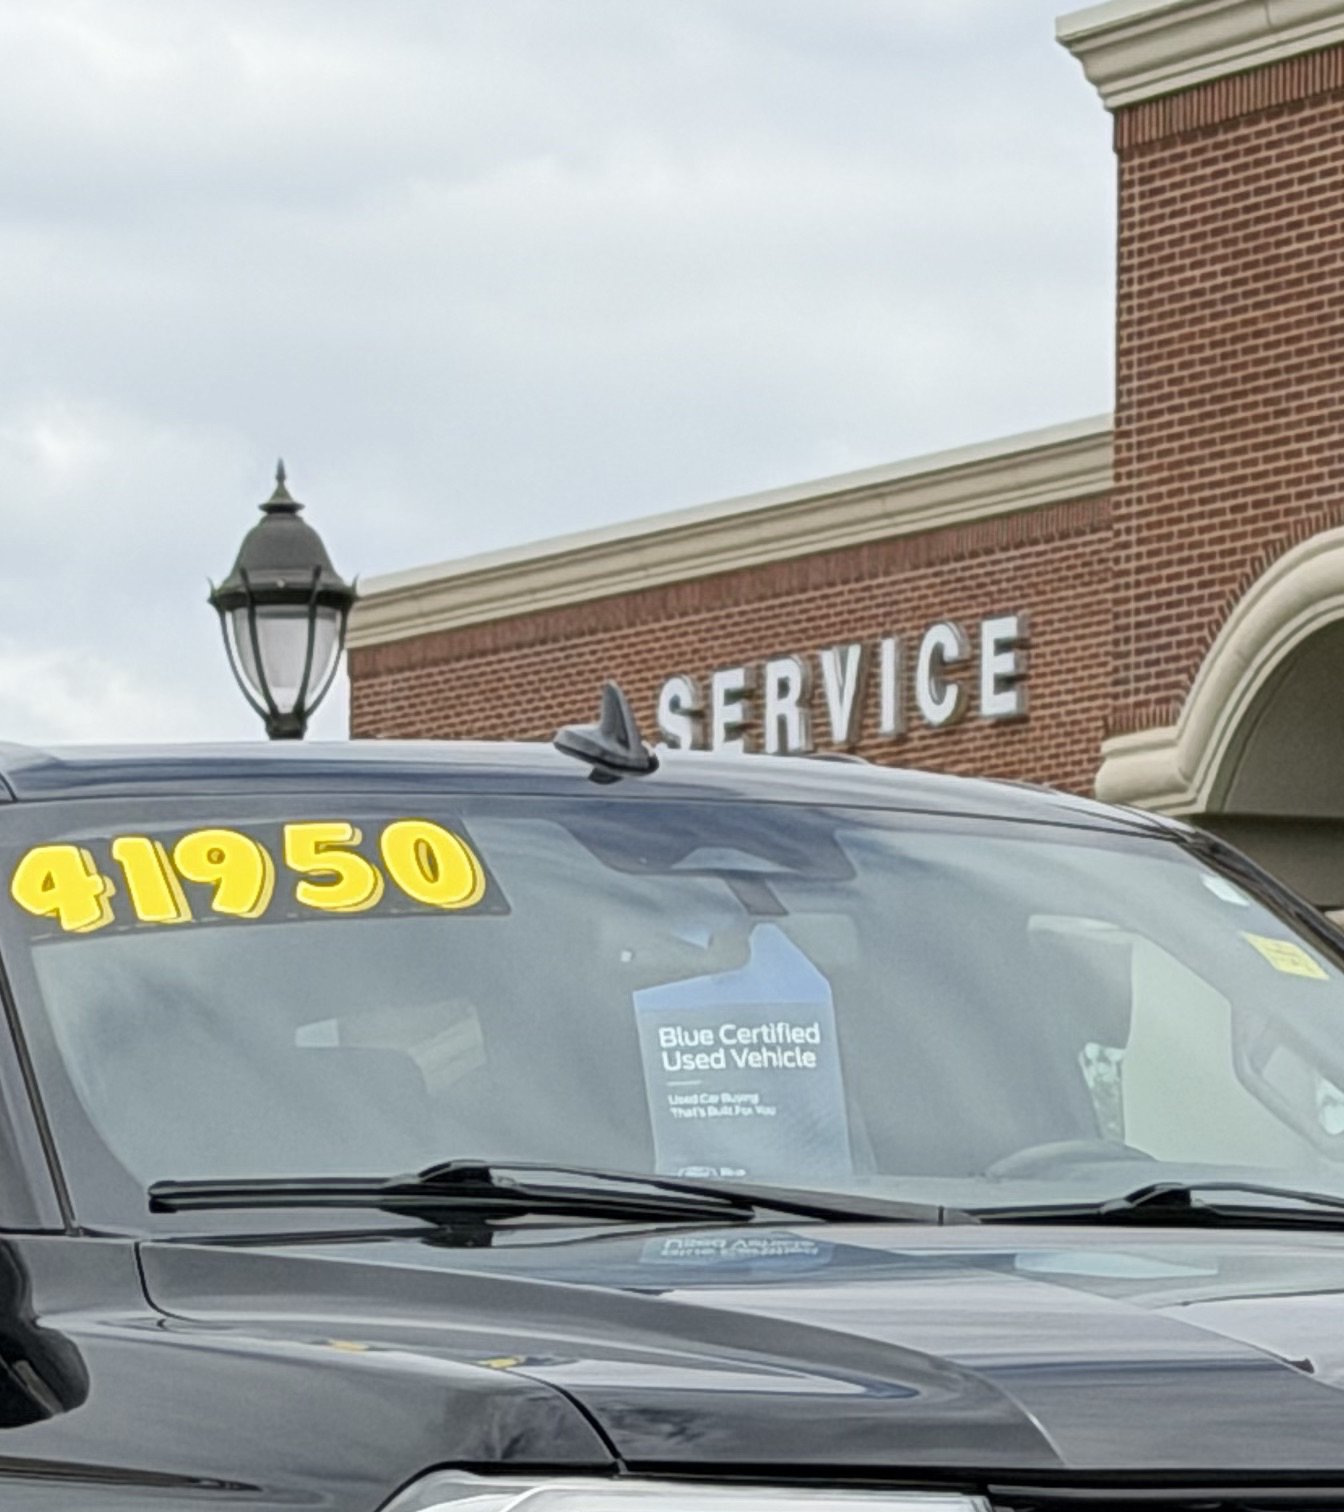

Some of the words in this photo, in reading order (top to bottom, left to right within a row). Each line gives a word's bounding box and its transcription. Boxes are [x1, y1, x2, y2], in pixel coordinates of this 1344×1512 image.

[658, 611, 1029, 752] SERVICE
[10, 817, 486, 933] 41950
[659, 1027, 714, 1048] Blue
[719, 1022, 821, 1045] Certified
[662, 1049, 726, 1071] Used
[730, 1047, 817, 1069] Vehicle
